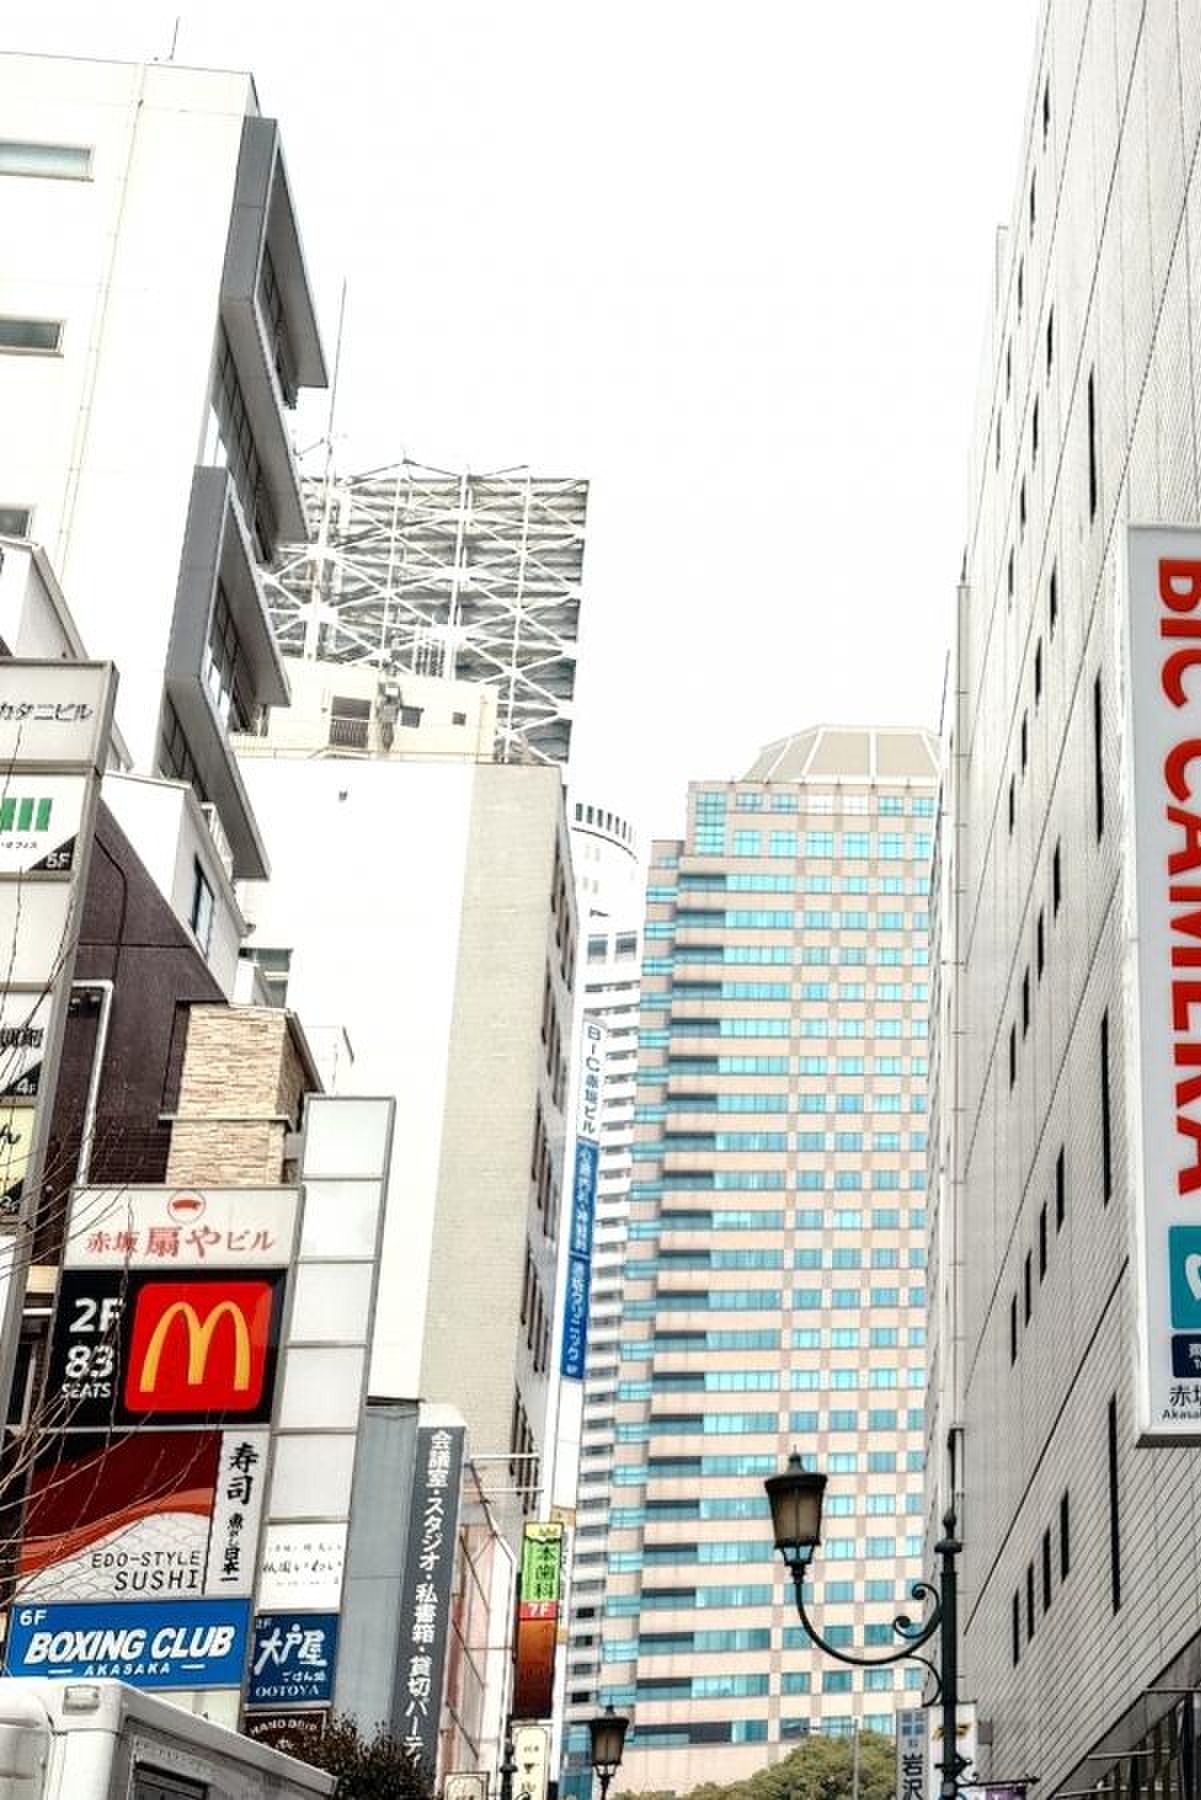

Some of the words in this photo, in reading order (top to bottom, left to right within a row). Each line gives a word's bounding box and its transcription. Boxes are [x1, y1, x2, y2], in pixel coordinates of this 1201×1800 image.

[69, 1297, 123, 1333] 2F
[65, 1345, 114, 1379] 83
[60, 1382, 111, 1399] SEATS
[228, 1441, 260, 1505] 寿司
[91, 1550, 201, 1569] EDO-STYLE
[114, 1569, 199, 1592] SUSHI
[19, 1609, 46, 1626] 6F
[24, 1628, 147, 1665] BOXING
[151, 1625, 236, 1659] CLUB
[254, 1623, 328, 1675] 大戸屋
[83, 1661, 171, 1678] AKASAKA
[255, 1683, 320, 1697] OOTOYA
